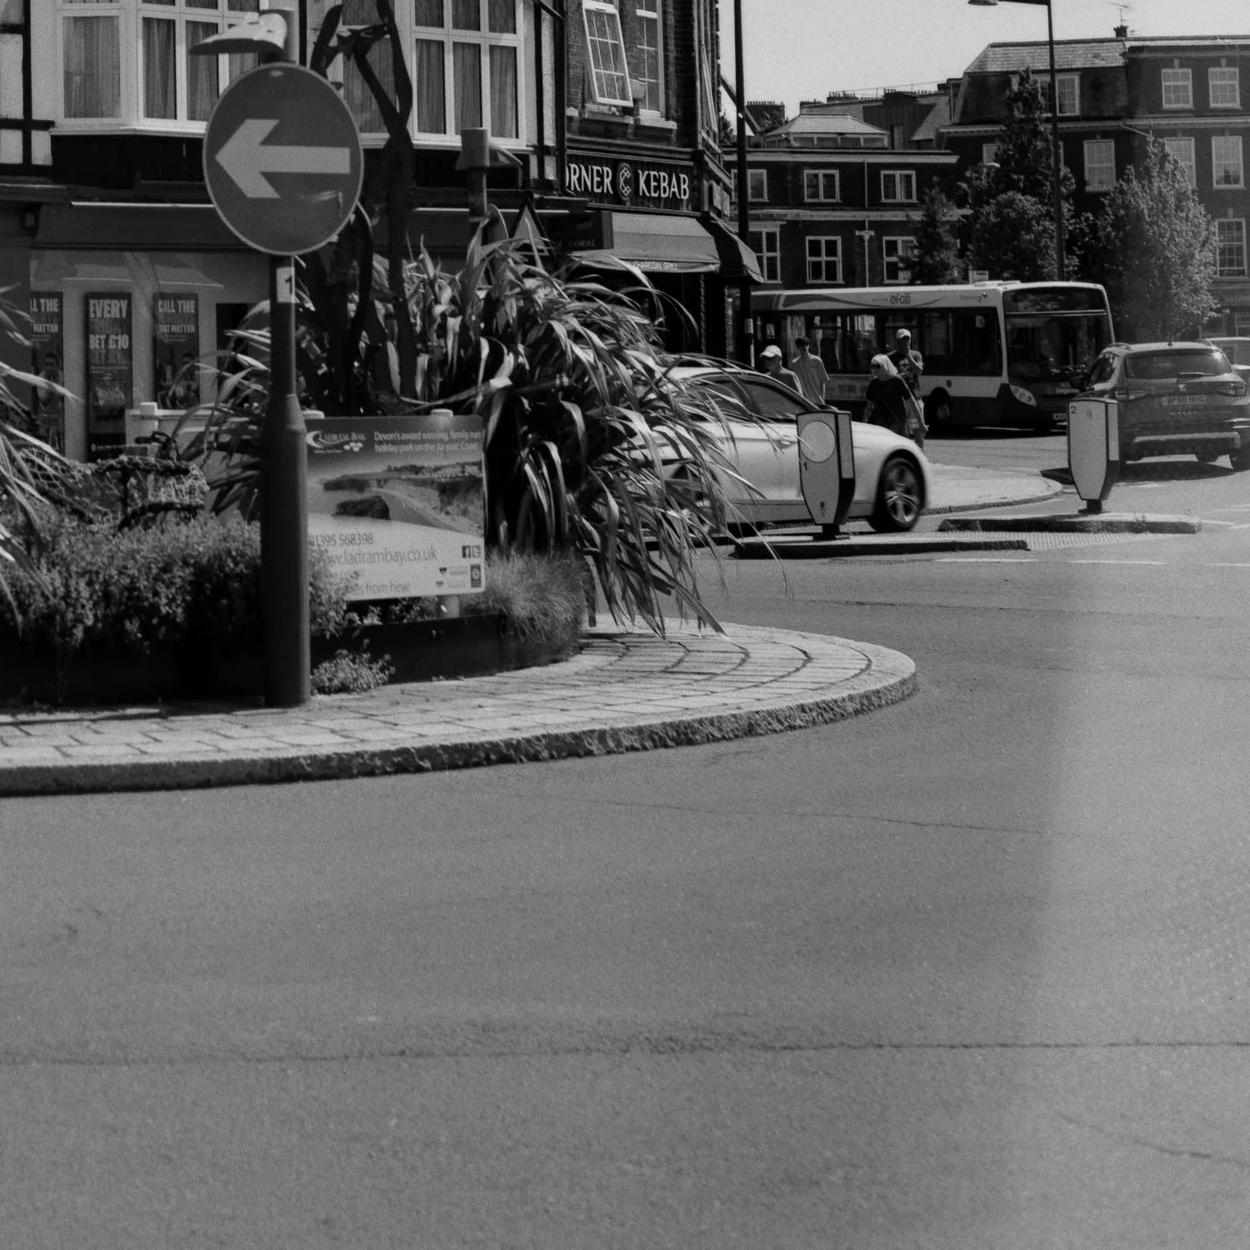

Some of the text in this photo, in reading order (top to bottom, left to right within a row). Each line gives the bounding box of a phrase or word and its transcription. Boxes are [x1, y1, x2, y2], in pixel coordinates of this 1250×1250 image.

[566, 163, 614, 195] RNER
[637, 169, 690, 200] KEBAB
[568, 238, 597, 247] CORAL
[40, 298, 59, 312] THE
[89, 299, 128, 319] EVERY
[158, 299, 195, 314] CALL THE
[171, 324, 196, 334] MATTER
[89, 334, 129, 350] BET £10
[1070, 405, 1078, 415] 2
[339, 532, 374, 546] 568398
